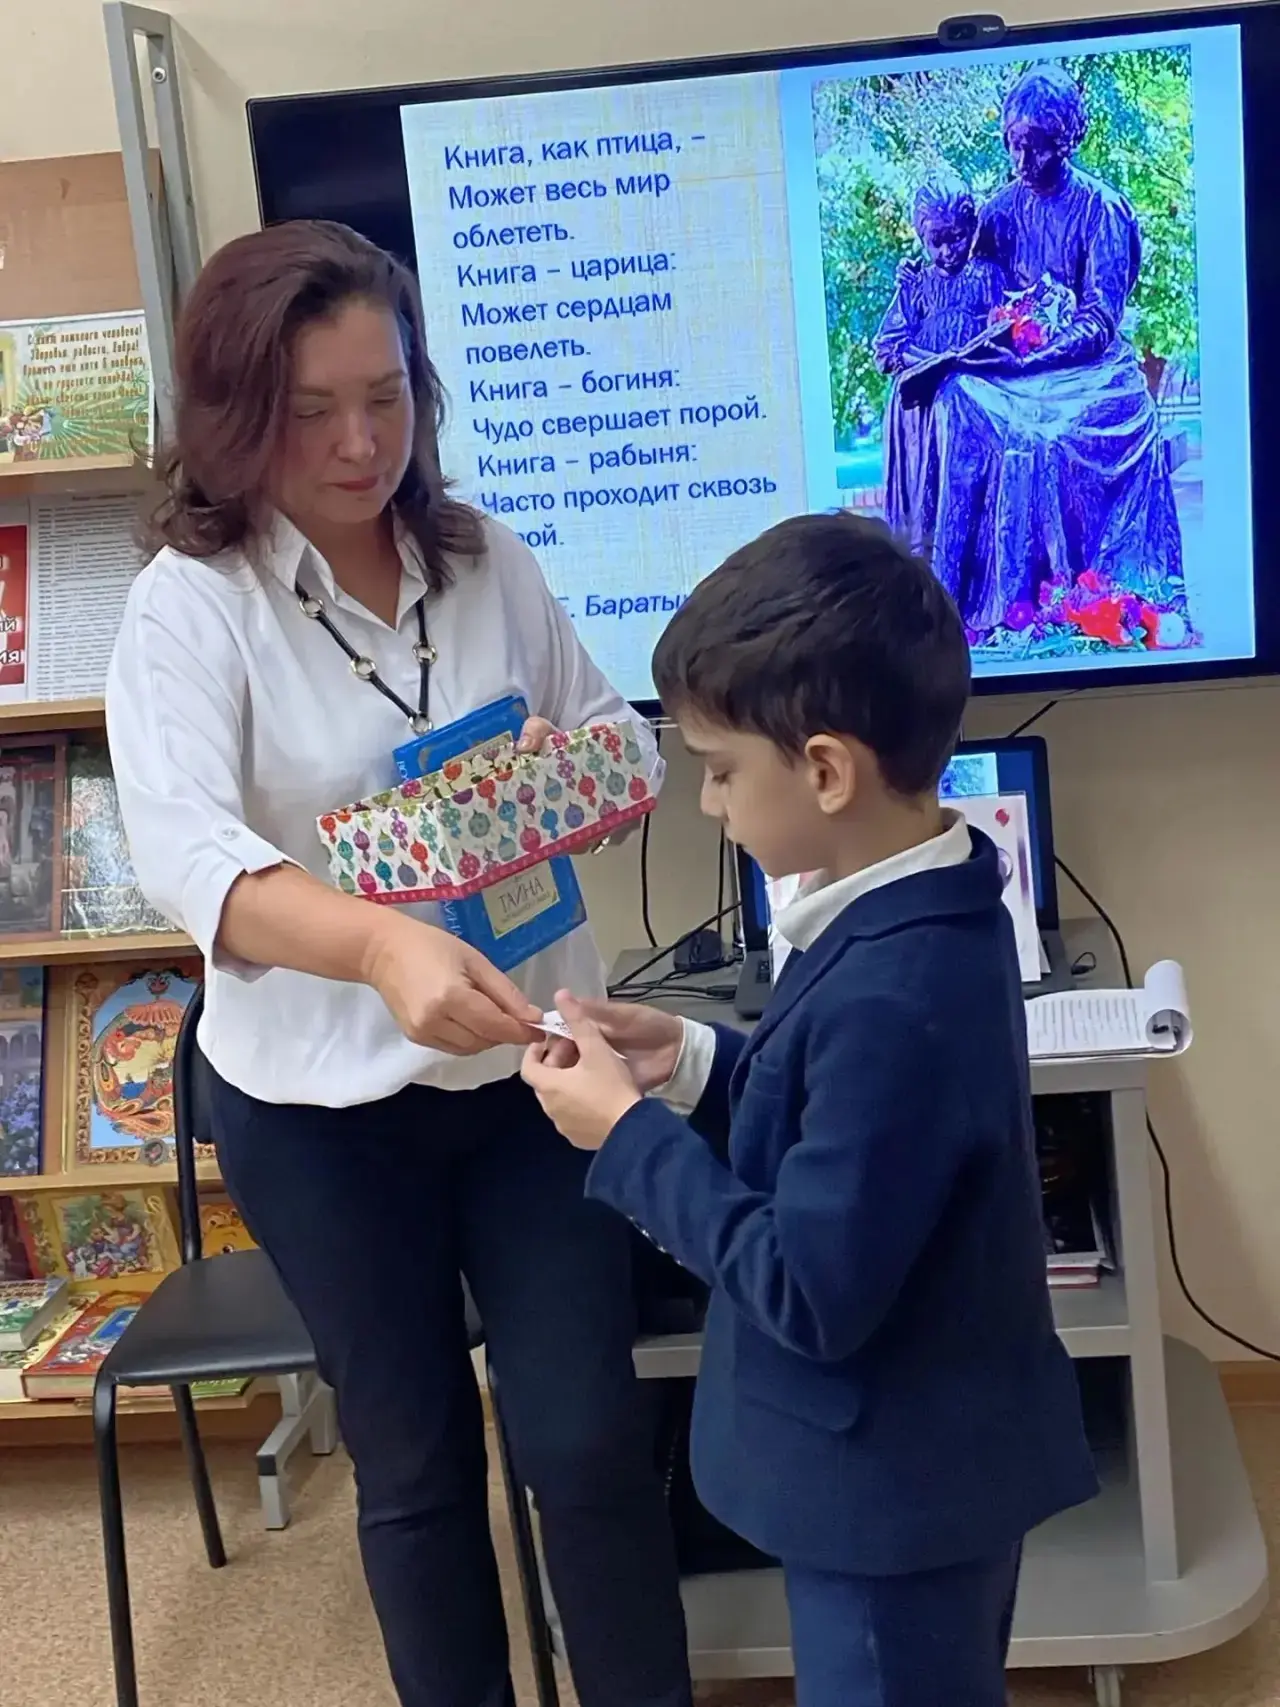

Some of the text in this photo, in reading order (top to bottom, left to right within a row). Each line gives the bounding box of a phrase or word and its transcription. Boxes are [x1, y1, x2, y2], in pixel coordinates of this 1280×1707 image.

[444, 144, 534, 170] Книга,
[541, 140, 590, 162] как
[596, 131, 682, 158] птица,
[448, 173, 672, 211] Может весь мир
[452, 223, 575, 250] облететь.
[456, 263, 537, 289] Книга
[570, 251, 677, 282] царица:
[460, 291, 672, 328] Может сердцам
[465, 338, 592, 365] повелеть.
[469, 379, 549, 404] Книга
[581, 368, 681, 394] богиня:
[472, 394, 767, 446] Чудо свершает порой.
[477, 454, 556, 478] Книга
[588, 443, 698, 475] рабыня:
[481, 476, 777, 515] Часто проходит сквозь
